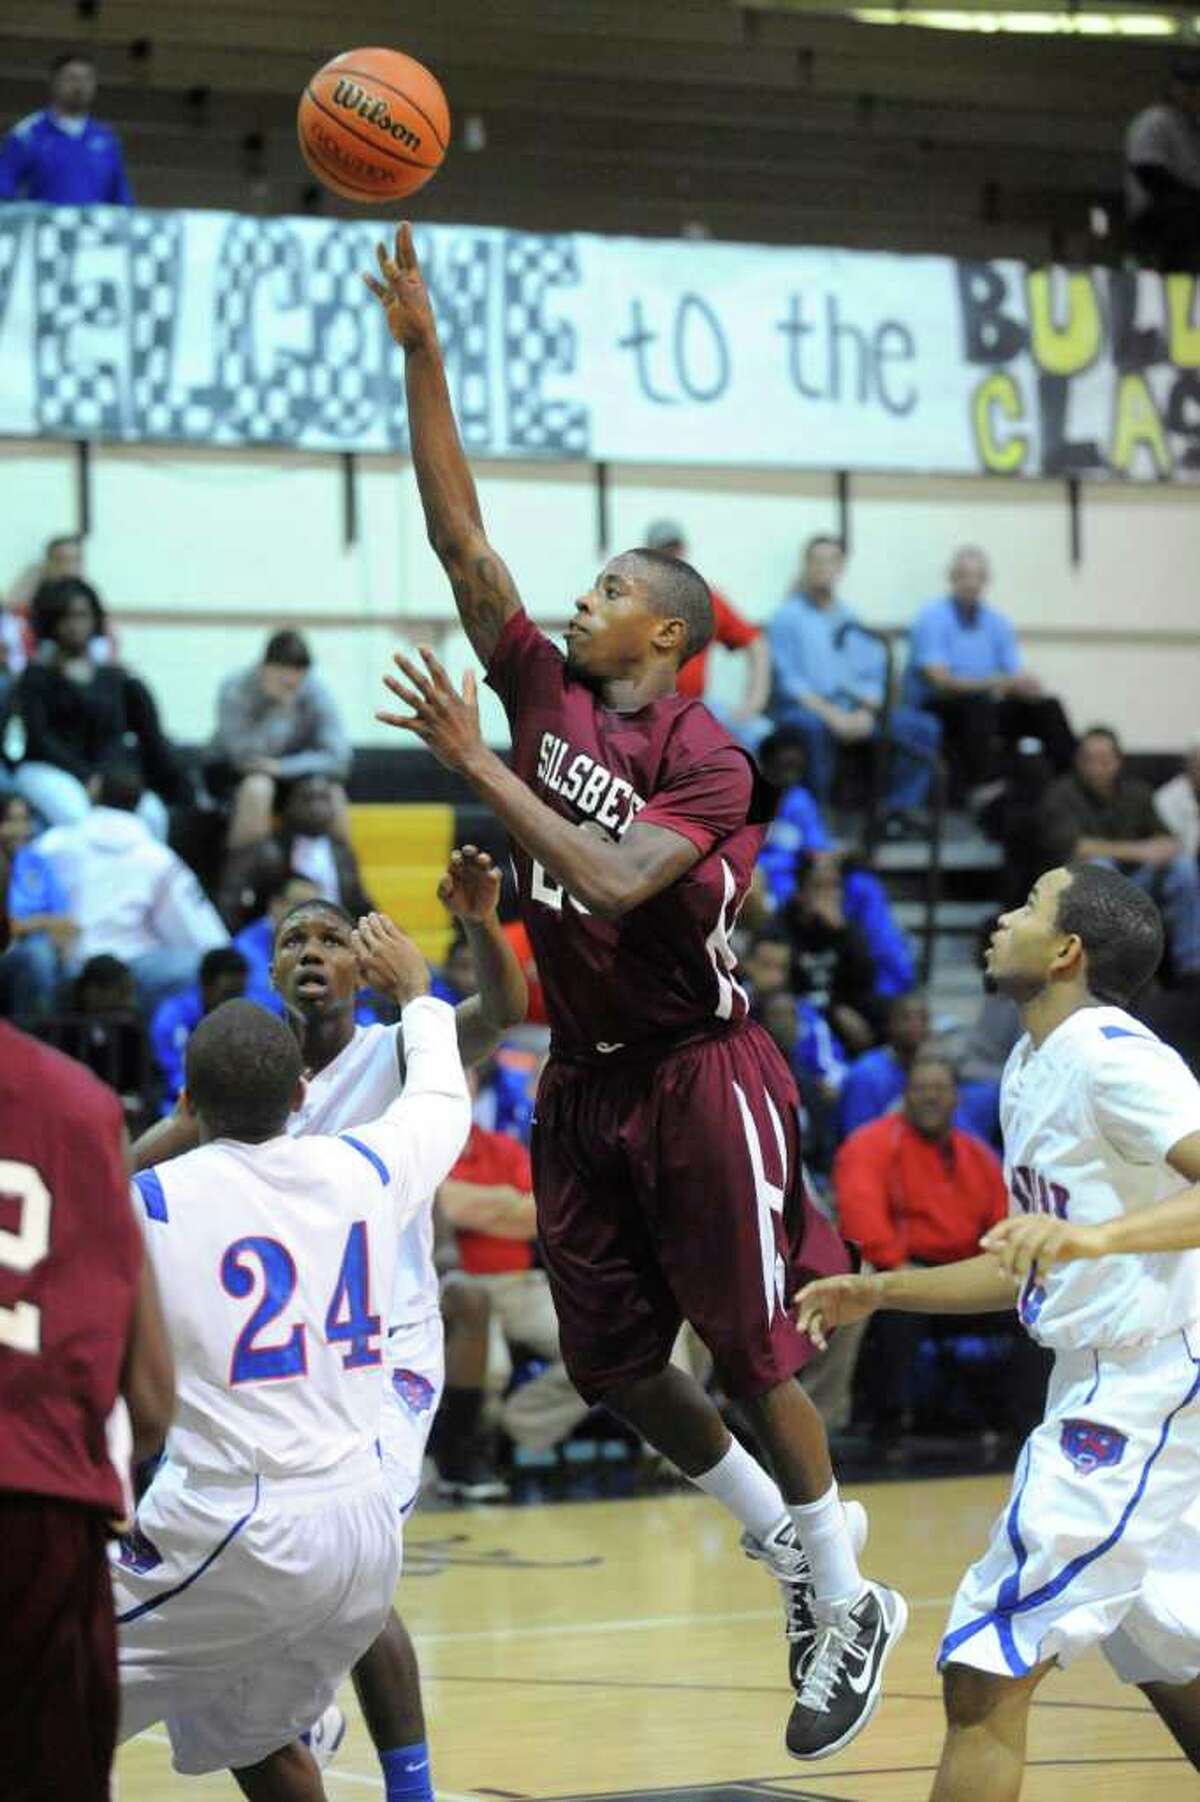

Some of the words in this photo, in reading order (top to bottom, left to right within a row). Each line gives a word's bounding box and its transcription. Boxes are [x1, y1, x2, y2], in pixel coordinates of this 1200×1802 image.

[333, 79, 421, 152] Wilson
[776, 292, 918, 417] the
[220, 1219, 383, 1388] 24
